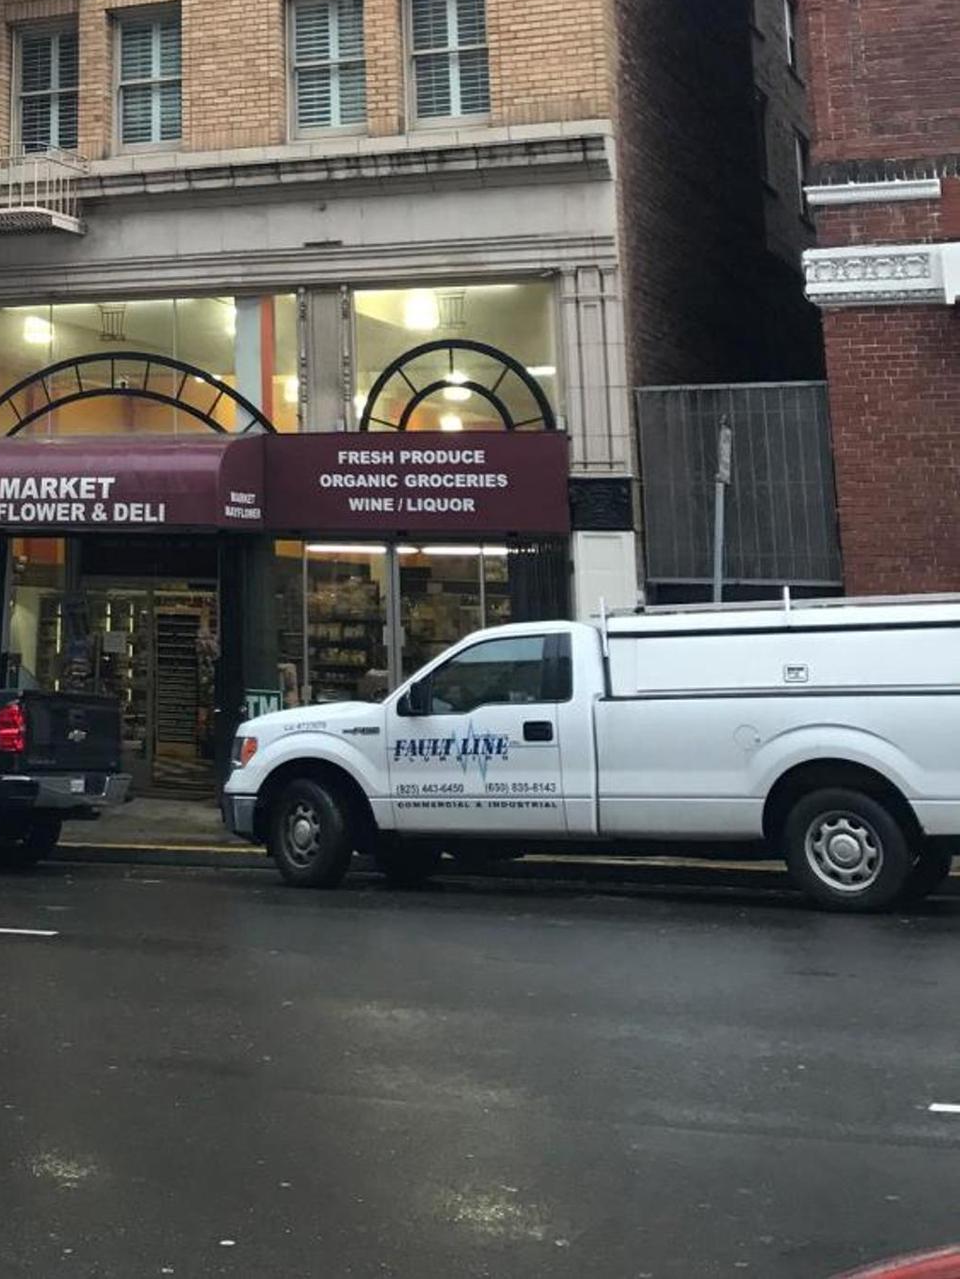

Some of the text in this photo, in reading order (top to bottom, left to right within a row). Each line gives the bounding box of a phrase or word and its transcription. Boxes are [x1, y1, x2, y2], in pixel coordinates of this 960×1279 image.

[337, 450, 486, 464] FRESH PRODUCE
[319, 474, 509, 488] ORGANIC GROCERIES
[91, 503, 107, 522] &
[113, 503, 166, 522] DELI
[348, 498, 476, 513] WINE / LIQUOR
[394, 738, 508, 756] FAULT LINE
